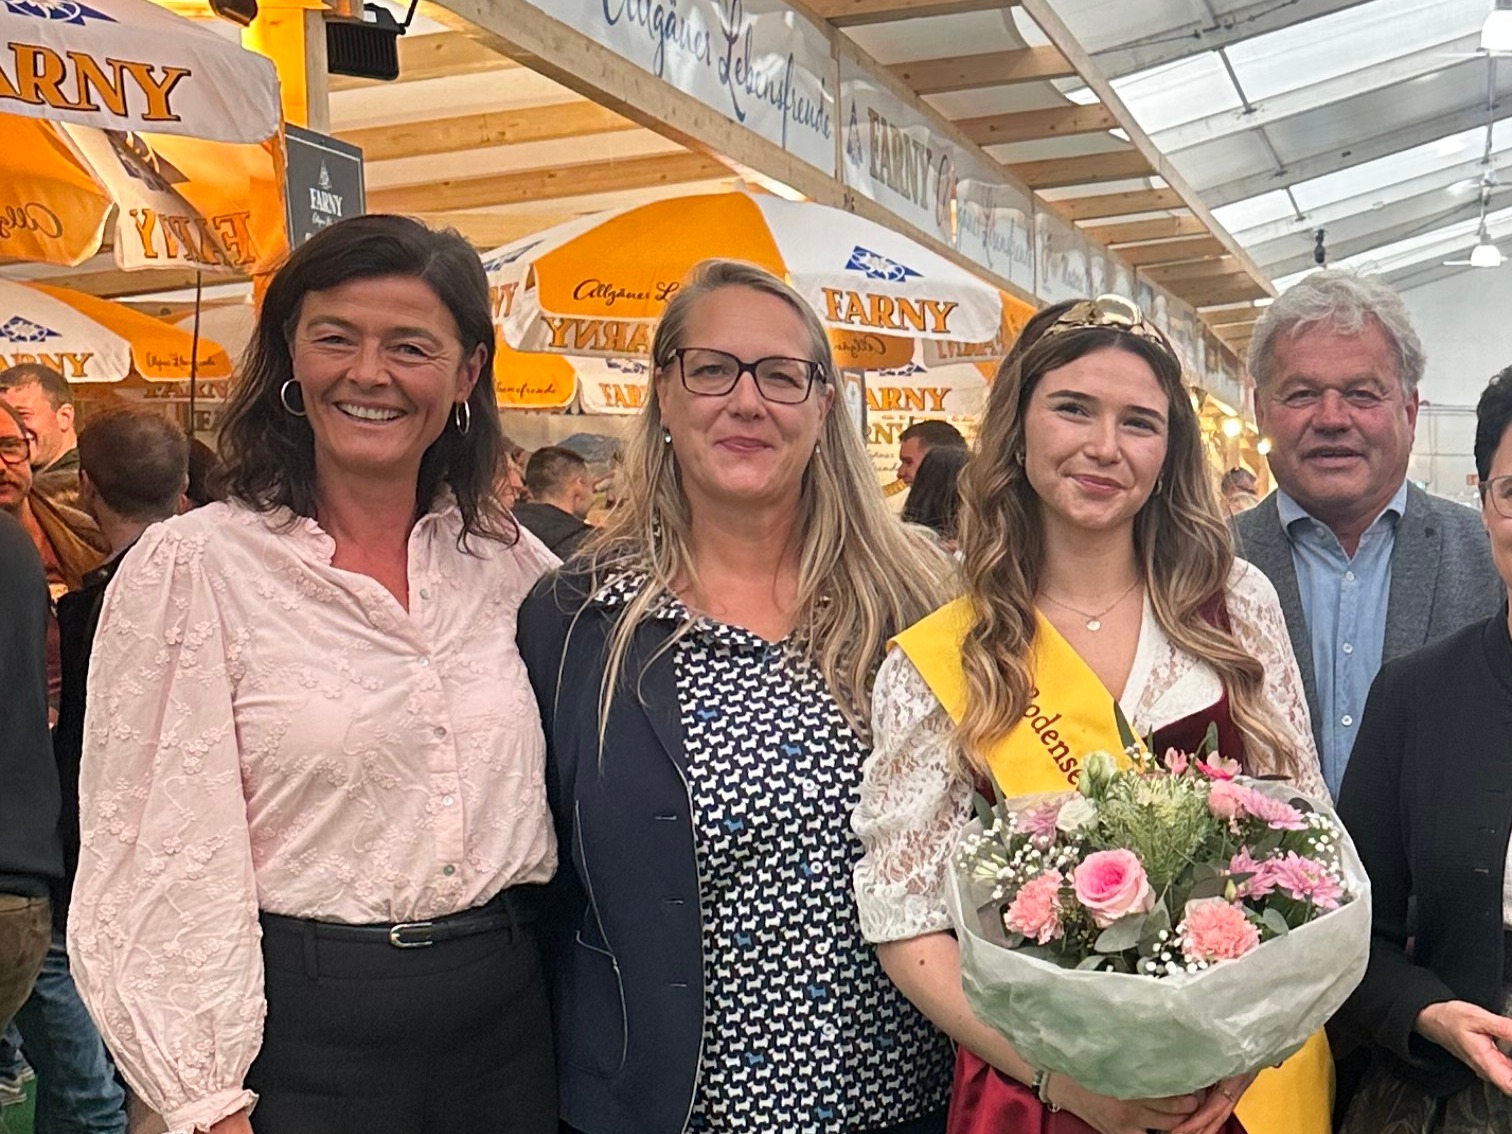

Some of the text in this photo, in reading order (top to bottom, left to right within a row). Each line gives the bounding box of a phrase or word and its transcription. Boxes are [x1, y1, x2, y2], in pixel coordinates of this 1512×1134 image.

[867, 106, 933, 211] FARNY
[309, 187, 343, 217] FARNY
[821, 287, 959, 334] FARNY
